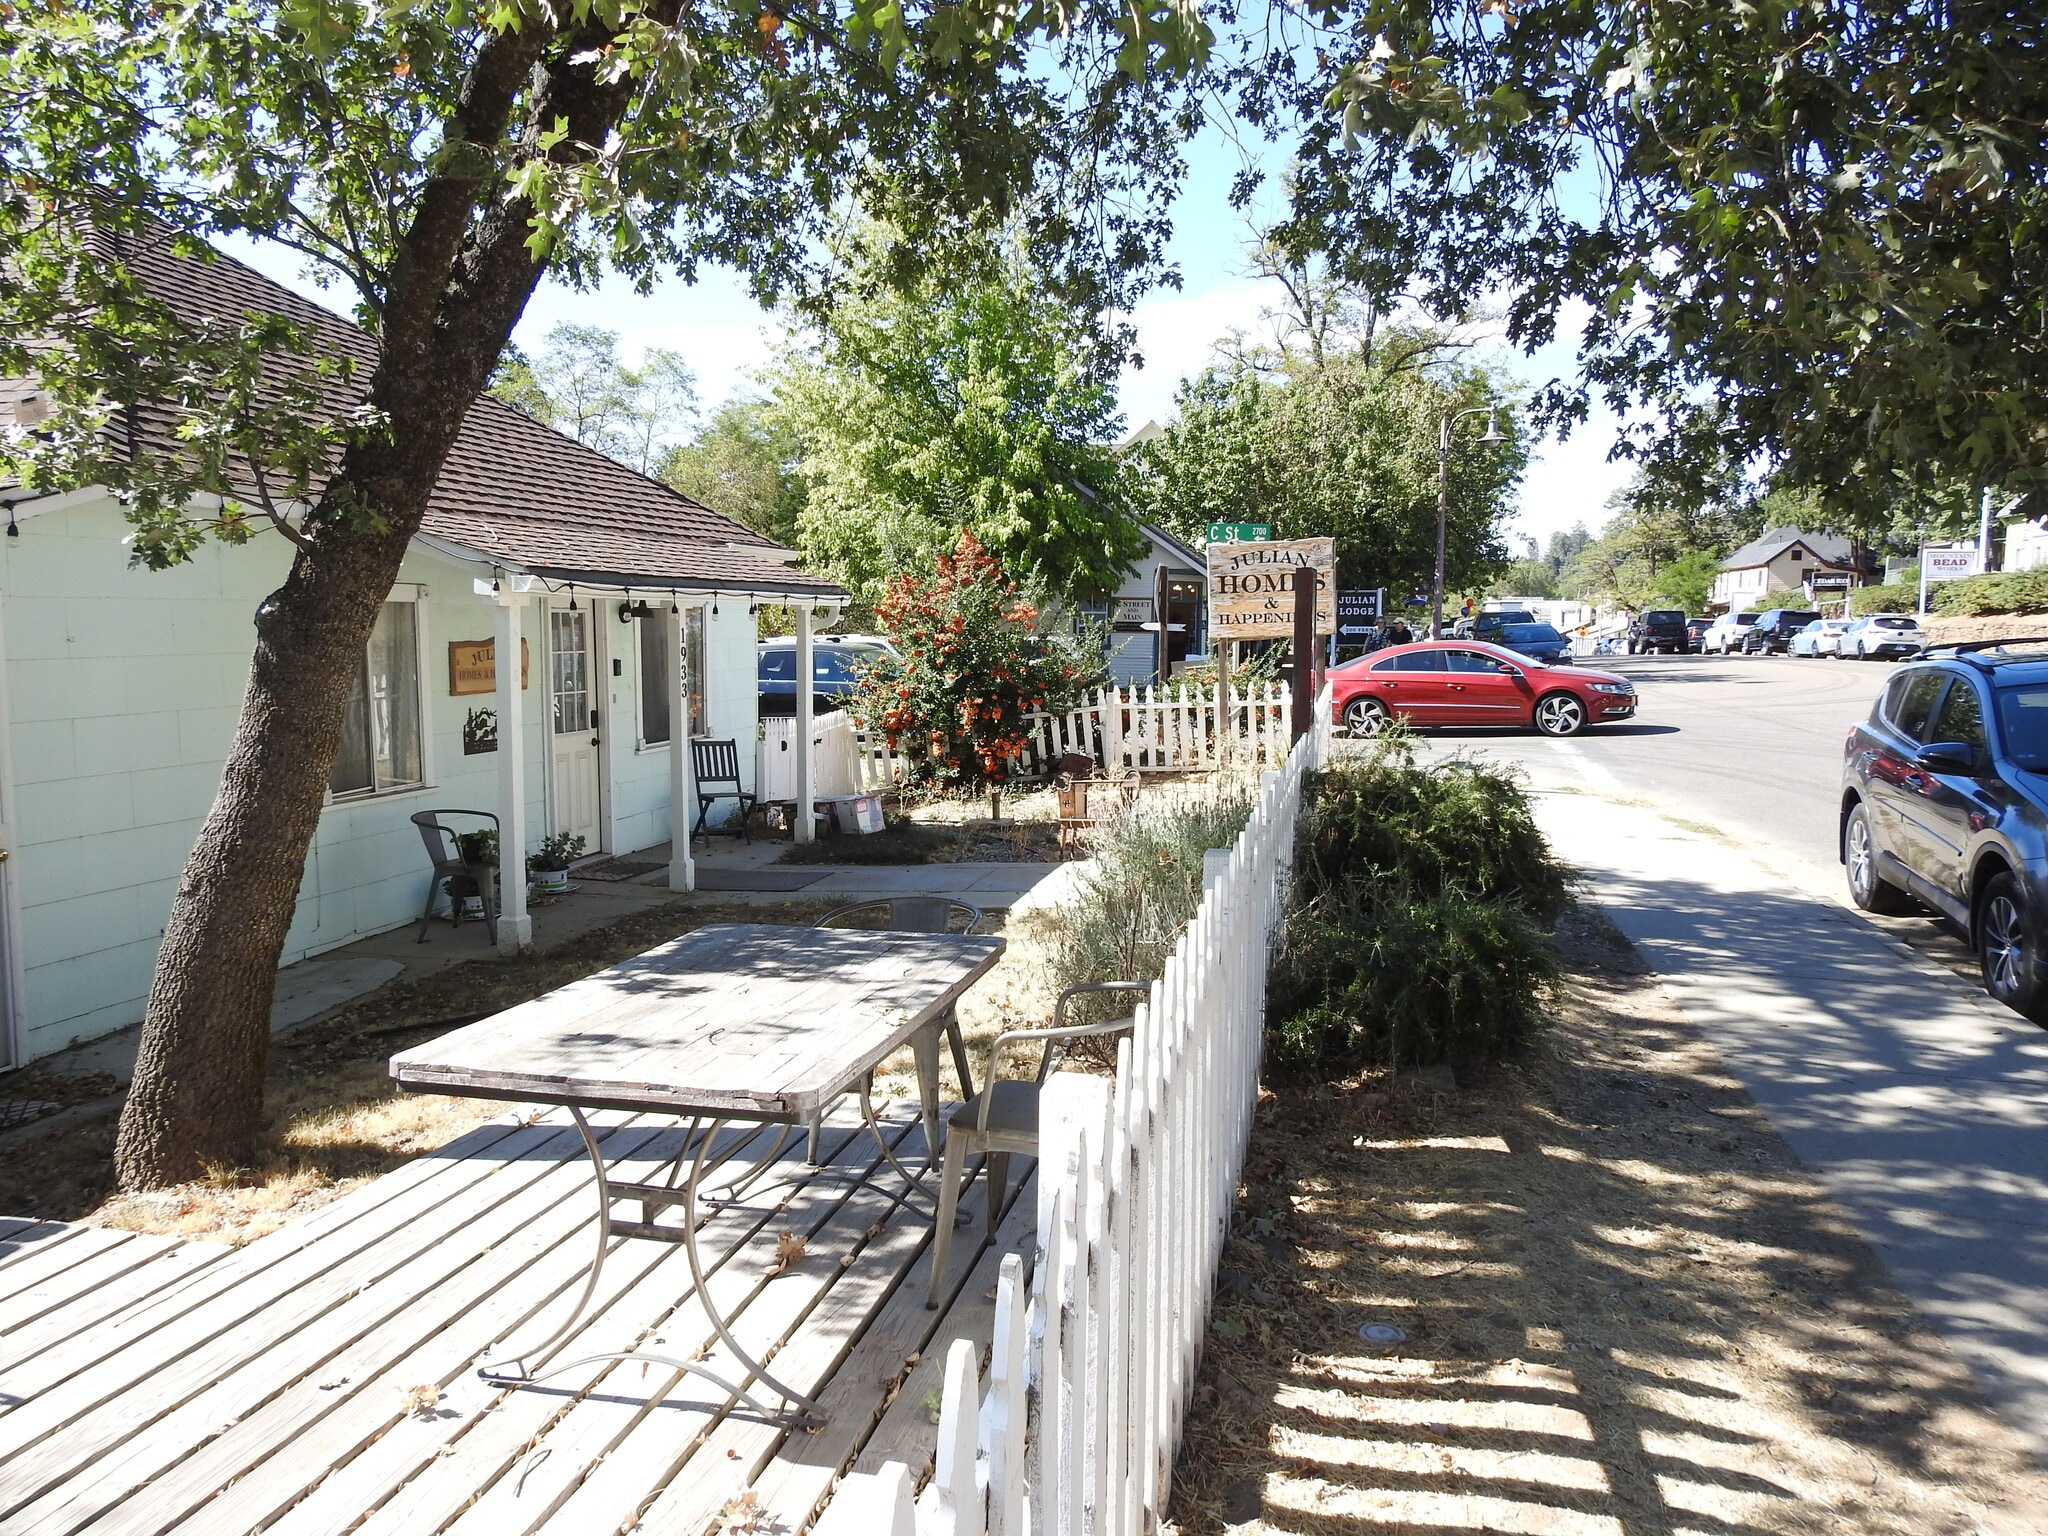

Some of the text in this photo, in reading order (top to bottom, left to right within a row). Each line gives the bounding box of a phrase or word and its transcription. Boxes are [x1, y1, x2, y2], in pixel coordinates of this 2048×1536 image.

[1210, 526, 1240, 540] C St
[1252, 527, 1267, 536] 2700
[1230, 550, 1311, 570] JULIAN
[1217, 573, 1326, 594] HOMS
[1122, 600, 1151, 608] STREET
[1264, 597, 1279, 610] &
[1338, 596, 1376, 604] JULIAN
[1339, 607, 1375, 615] LODGE
[1219, 611, 1327, 625] HAPPENIS
[680, 627, 688, 698] 1933
[459, 669, 482, 681] HOMES
